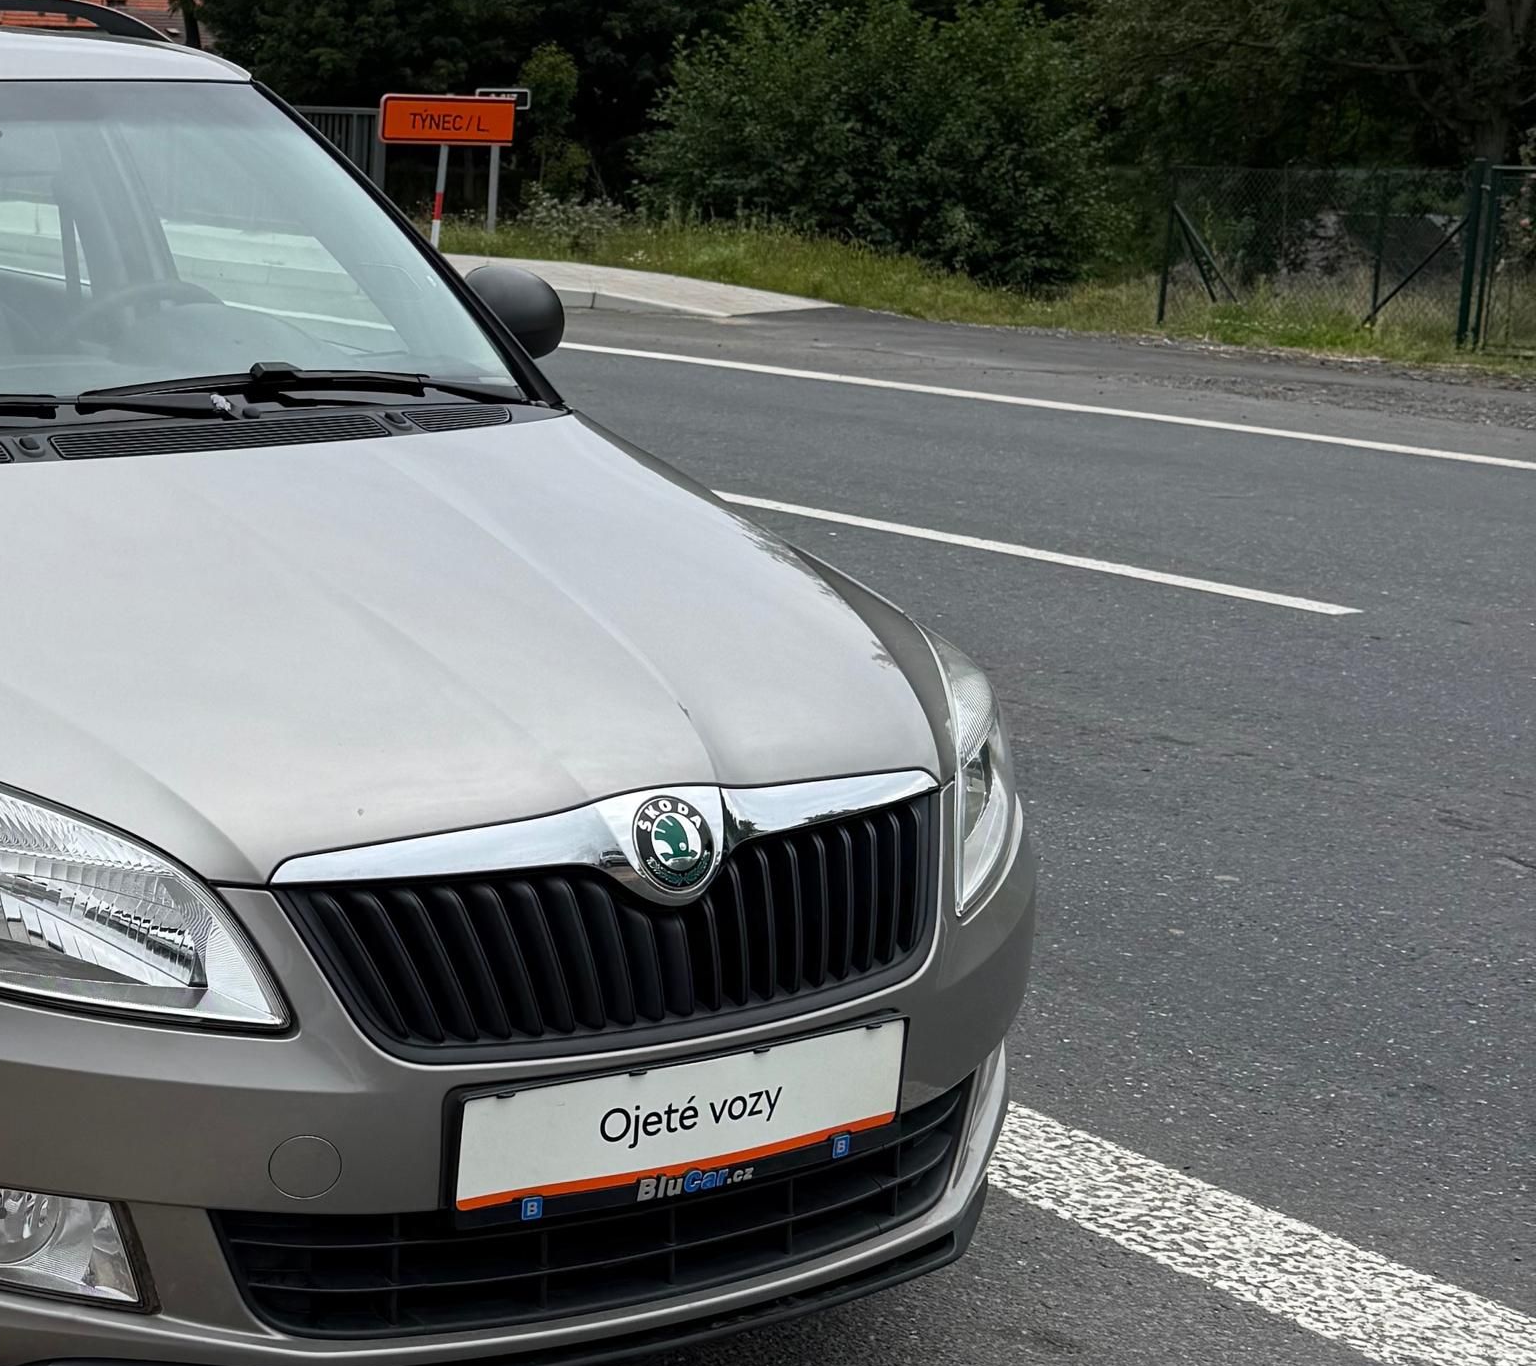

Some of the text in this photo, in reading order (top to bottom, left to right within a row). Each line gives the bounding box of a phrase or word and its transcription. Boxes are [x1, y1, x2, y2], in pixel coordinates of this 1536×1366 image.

[599, 1086, 783, 1149] Ojeté vozy
[636, 1166, 755, 1202] BluCar.cz
